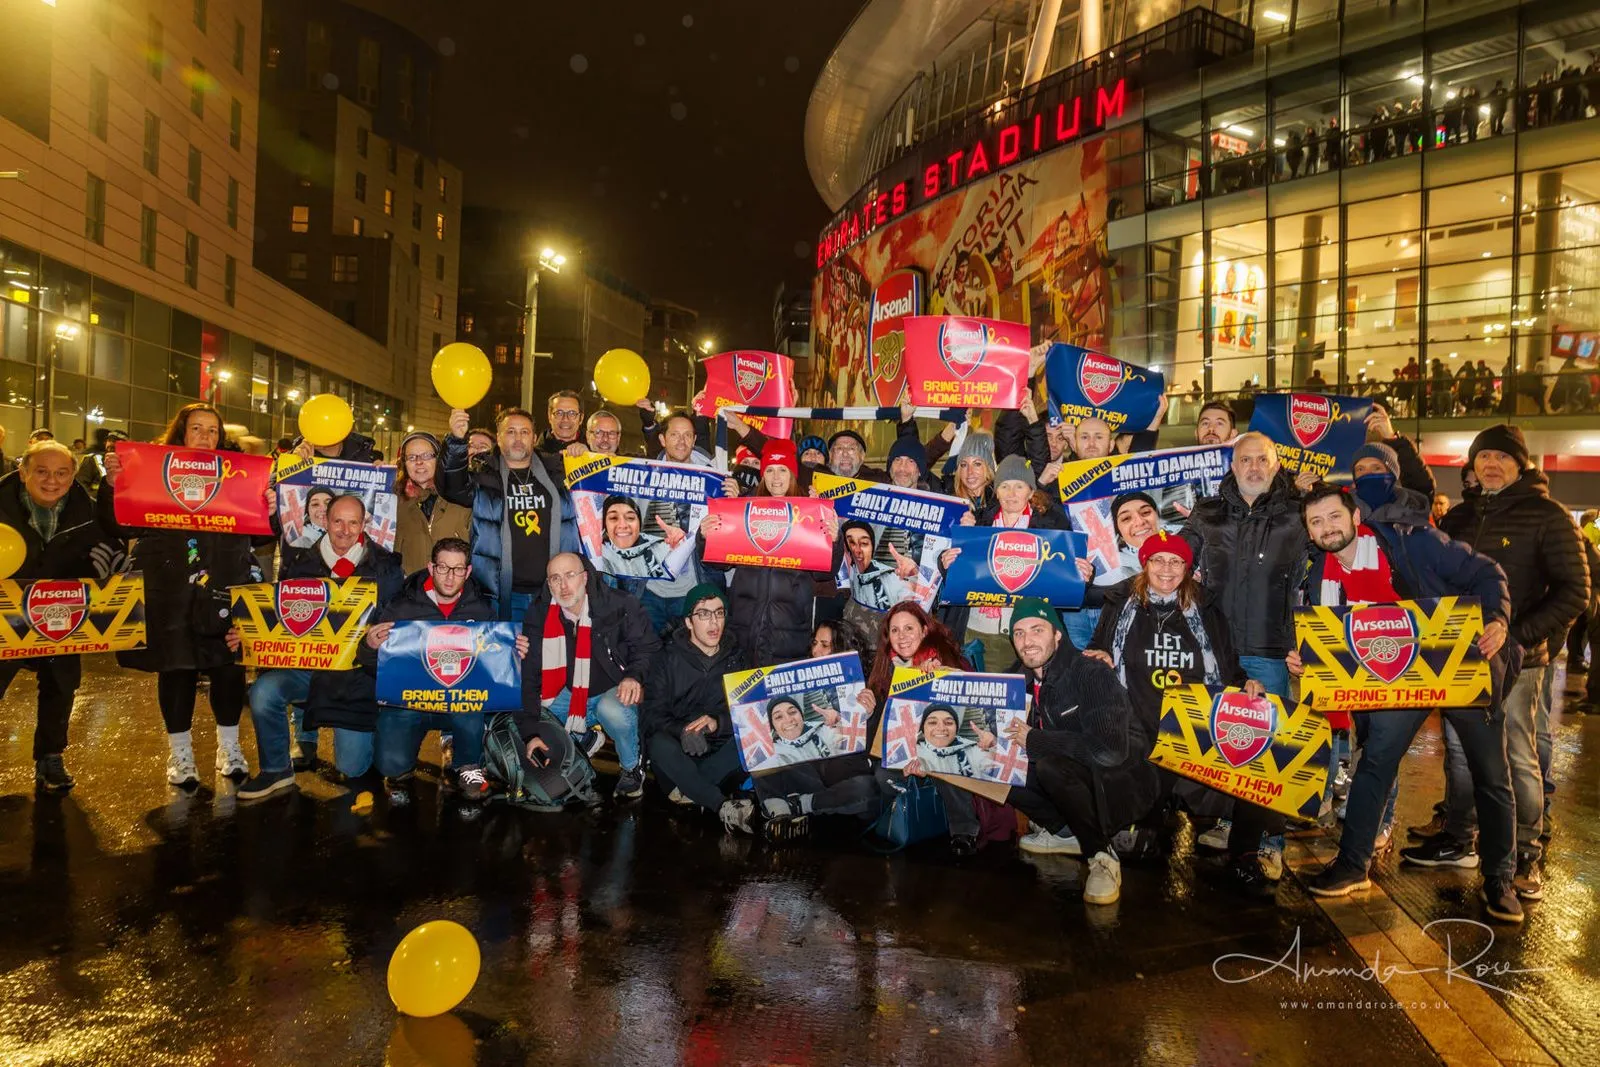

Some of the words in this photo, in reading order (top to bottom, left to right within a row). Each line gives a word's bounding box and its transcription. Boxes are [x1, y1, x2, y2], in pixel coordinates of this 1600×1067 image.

[817, 182, 907, 269] EMIRATES
[924, 78, 1126, 198] STADIUM
[872, 288, 913, 323] Arsenal
[738, 357, 765, 372] Arsenal
[1085, 357, 1120, 373] Arsenal
[923, 381, 960, 393] BRING
[962, 382, 998, 394] THEM
[927, 393, 962, 405] HOME
[964, 394, 992, 405] NOW
[1293, 398, 1328, 413] Arsenal
[1095, 408, 1128, 424] THEM
[1275, 443, 1301, 460] RING
[1303, 449, 1336, 468] THEM
[170, 457, 216, 471] Arsenal
[278, 457, 315, 479] KIDNAPPED
[567, 458, 612, 485] KIDNAPPED
[1112, 458, 1155, 483] EMILY
[1158, 449, 1222, 475] DAMARI
[312, 465, 343, 481] EMILY
[344, 467, 387, 483] DAMARI
[607, 466, 648, 486] EMILY
[650, 471, 706, 491] DAMARI
[1062, 459, 1114, 498] KIDNAPPED
[1113, 478, 1146, 492] ...SHE'S
[1148, 475, 1167, 488] ONE
[1169, 473, 1181, 485] OF
[1182, 470, 1202, 483] OUR
[1203, 466, 1223, 479] OWN
[335, 480, 349, 488] ONE
[350, 481, 359, 489] OF
[511, 483, 533, 497] LET
[606, 483, 637, 494] ...SHE'S
[638, 485, 655, 496] ONE
[657, 487, 668, 497] OF
[669, 489, 685, 499] OUR
[687, 491, 705, 502] OWN
[507, 495, 546, 510] THEM
[852, 492, 888, 513] EMILY
[889, 498, 944, 523] DAMARI
[752, 506, 787, 517] Arsenal
[144, 513, 191, 525] BRING
[196, 514, 236, 526] THEM
[847, 508, 877, 521] ...SHE'S
[879, 512, 895, 523] ONE
[895, 515, 906, 526] OF
[907, 517, 922, 529] OUR
[923, 520, 940, 532] OWN
[996, 541, 1036, 553] Arsenal
[725, 554, 762, 564] BRING
[766, 555, 801, 565] THEM
[32, 588, 83, 599] Arsenal
[281, 585, 323, 596] Arsenal
[966, 591, 1008, 603] BRING
[1353, 617, 1409, 632] Arsenal
[2, 645, 56, 657] BRING
[58, 642, 109, 653] THEM
[253, 640, 296, 653] BRING
[300, 642, 339, 655] THEM
[1153, 633, 1181, 651] LET
[258, 655, 297, 667] HOME
[299, 656, 332, 667] NOW
[1145, 648, 1194, 669] THEM
[765, 667, 797, 688] EMILY
[798, 662, 842, 682] DAMARI
[730, 668, 765, 699] KIDNAPPED
[806, 680, 816, 690] OF
[816, 678, 829, 688] OUR
[892, 673, 936, 693] KIDNAPPED
[931, 678, 964, 696] EMILY
[965, 680, 1007, 697] DAMARI
[402, 689, 445, 701] BRING
[448, 690, 488, 701] THEM
[957, 696, 970, 705] ONE
[971, 697, 980, 705] OF
[981, 697, 992, 706] OUR
[993, 698, 1006, 707] OWN
[1334, 689, 1388, 702] BRING
[1392, 689, 1446, 701] THEM
[408, 702, 447, 712] HOME
[450, 702, 483, 712] NOW
[1220, 702, 1270, 722] Arsenal
[1180, 761, 1232, 783] BRING
[1234, 773, 1283, 797] THEM
